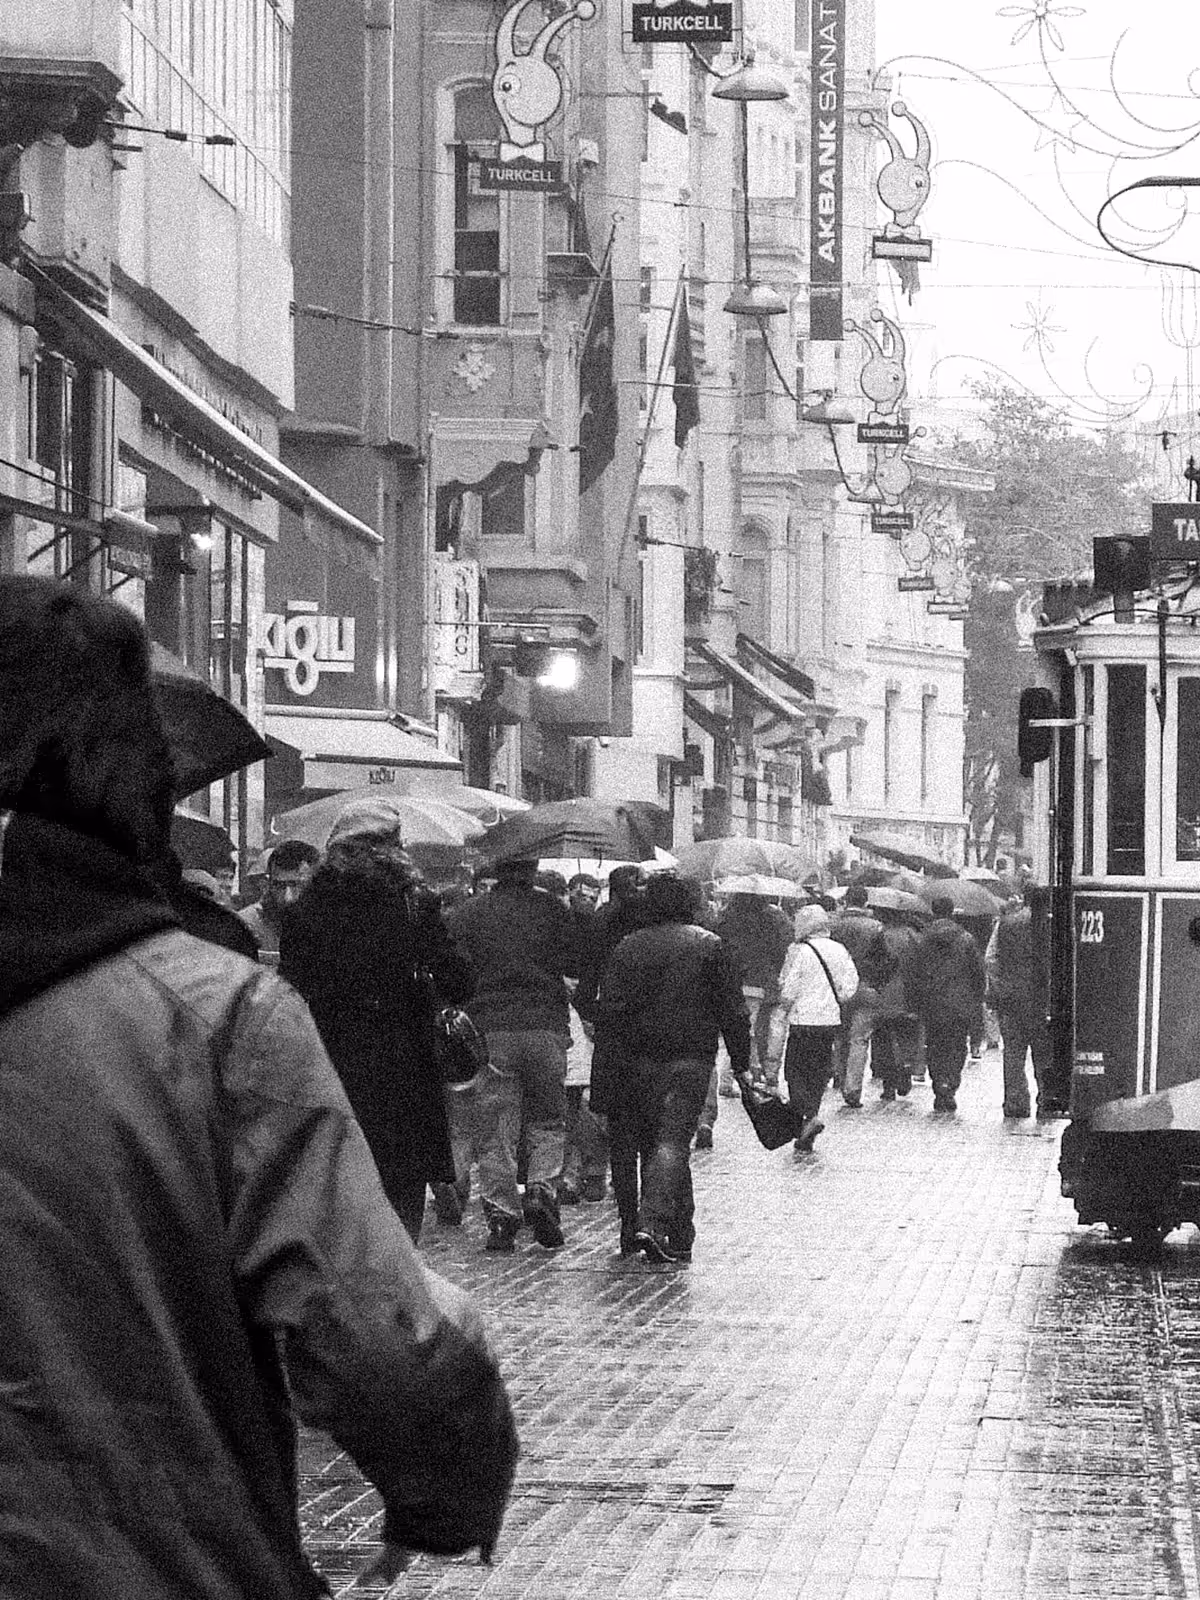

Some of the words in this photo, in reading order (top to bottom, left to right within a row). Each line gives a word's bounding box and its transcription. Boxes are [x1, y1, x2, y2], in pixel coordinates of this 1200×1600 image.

[640, 15, 723, 31] TURKCELL
[817, 1, 838, 112] SANAT
[487, 167, 556, 183] TURKCELL
[817, 119, 838, 263] AKBANK
[1080, 910, 1105, 943] 223
